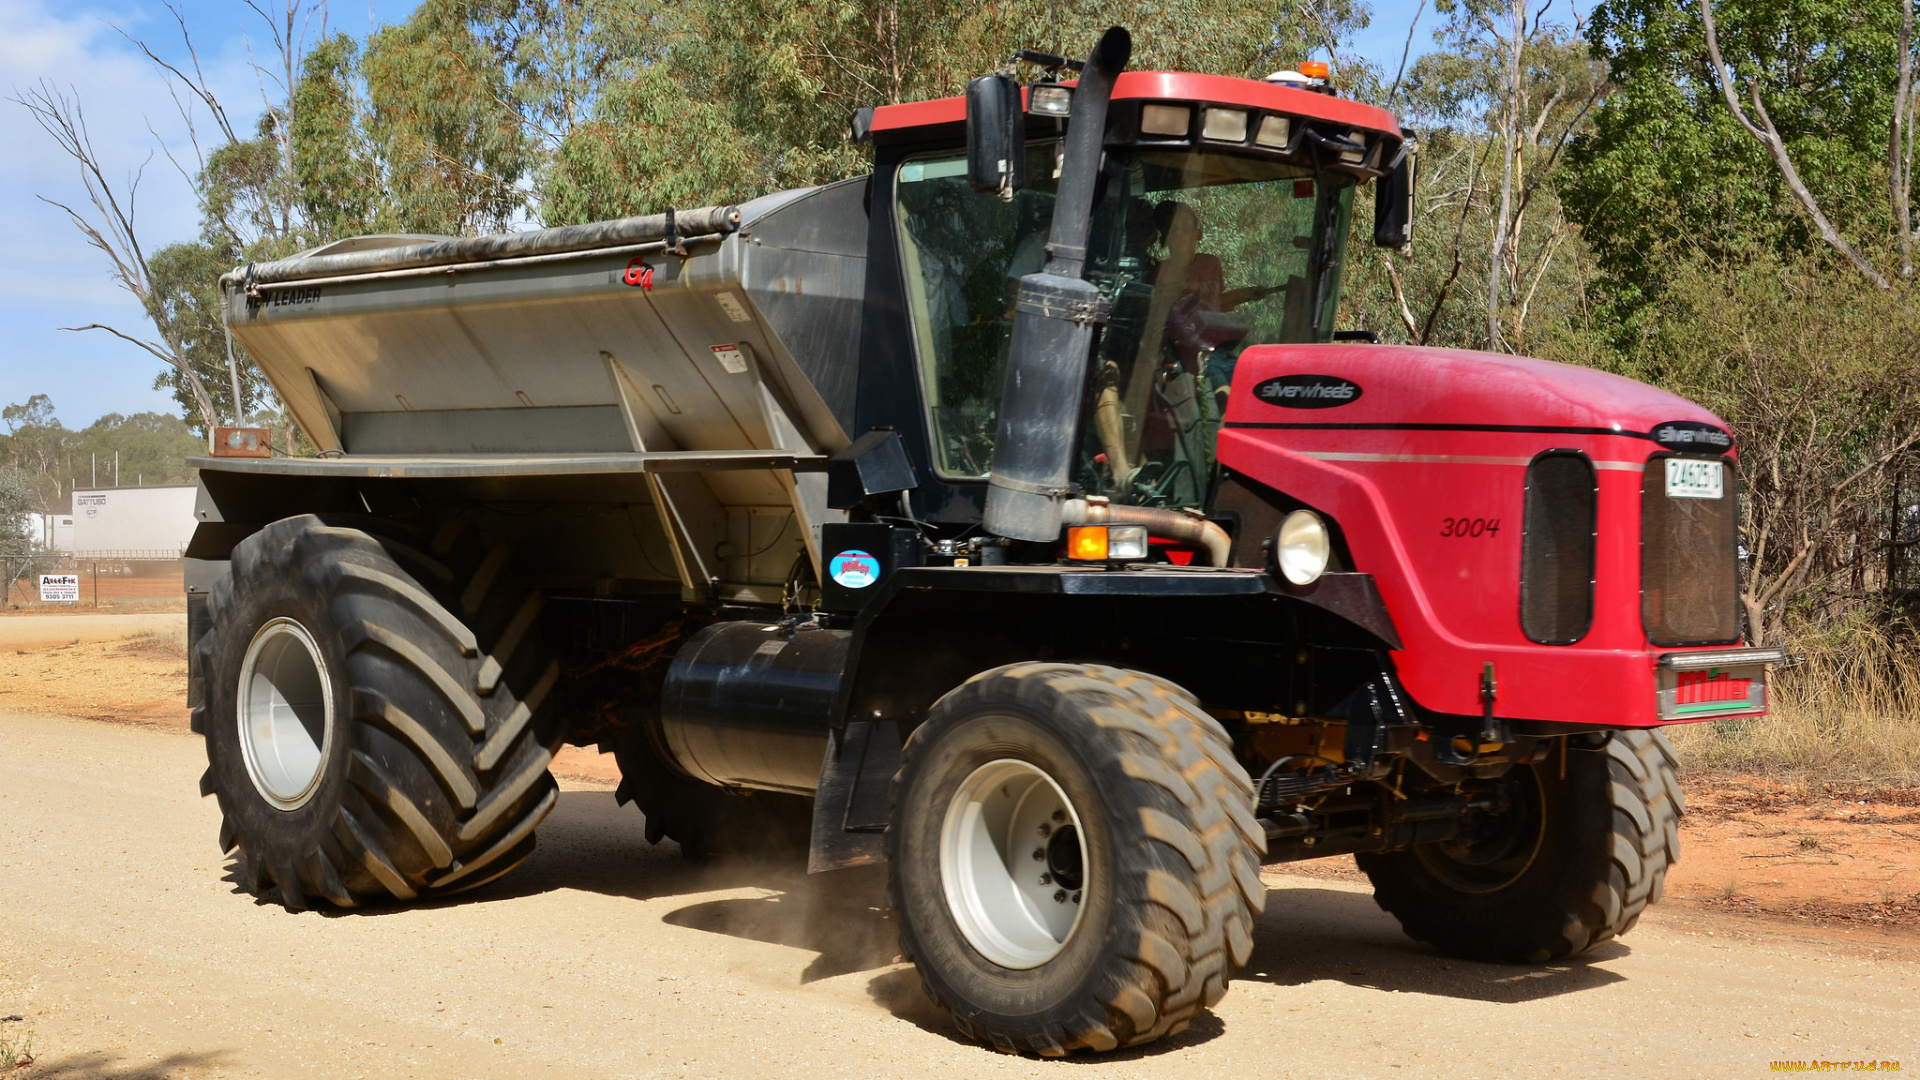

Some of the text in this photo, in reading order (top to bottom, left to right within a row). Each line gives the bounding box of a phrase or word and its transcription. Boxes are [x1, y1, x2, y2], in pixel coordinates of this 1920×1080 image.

[624, 257, 653, 292] G4
[274, 287, 322, 307] LEADER
[1261, 382, 1354, 399] silverwheels
[1658, 426, 1730, 446] silverwheels
[1440, 517, 1501, 538] 3004
